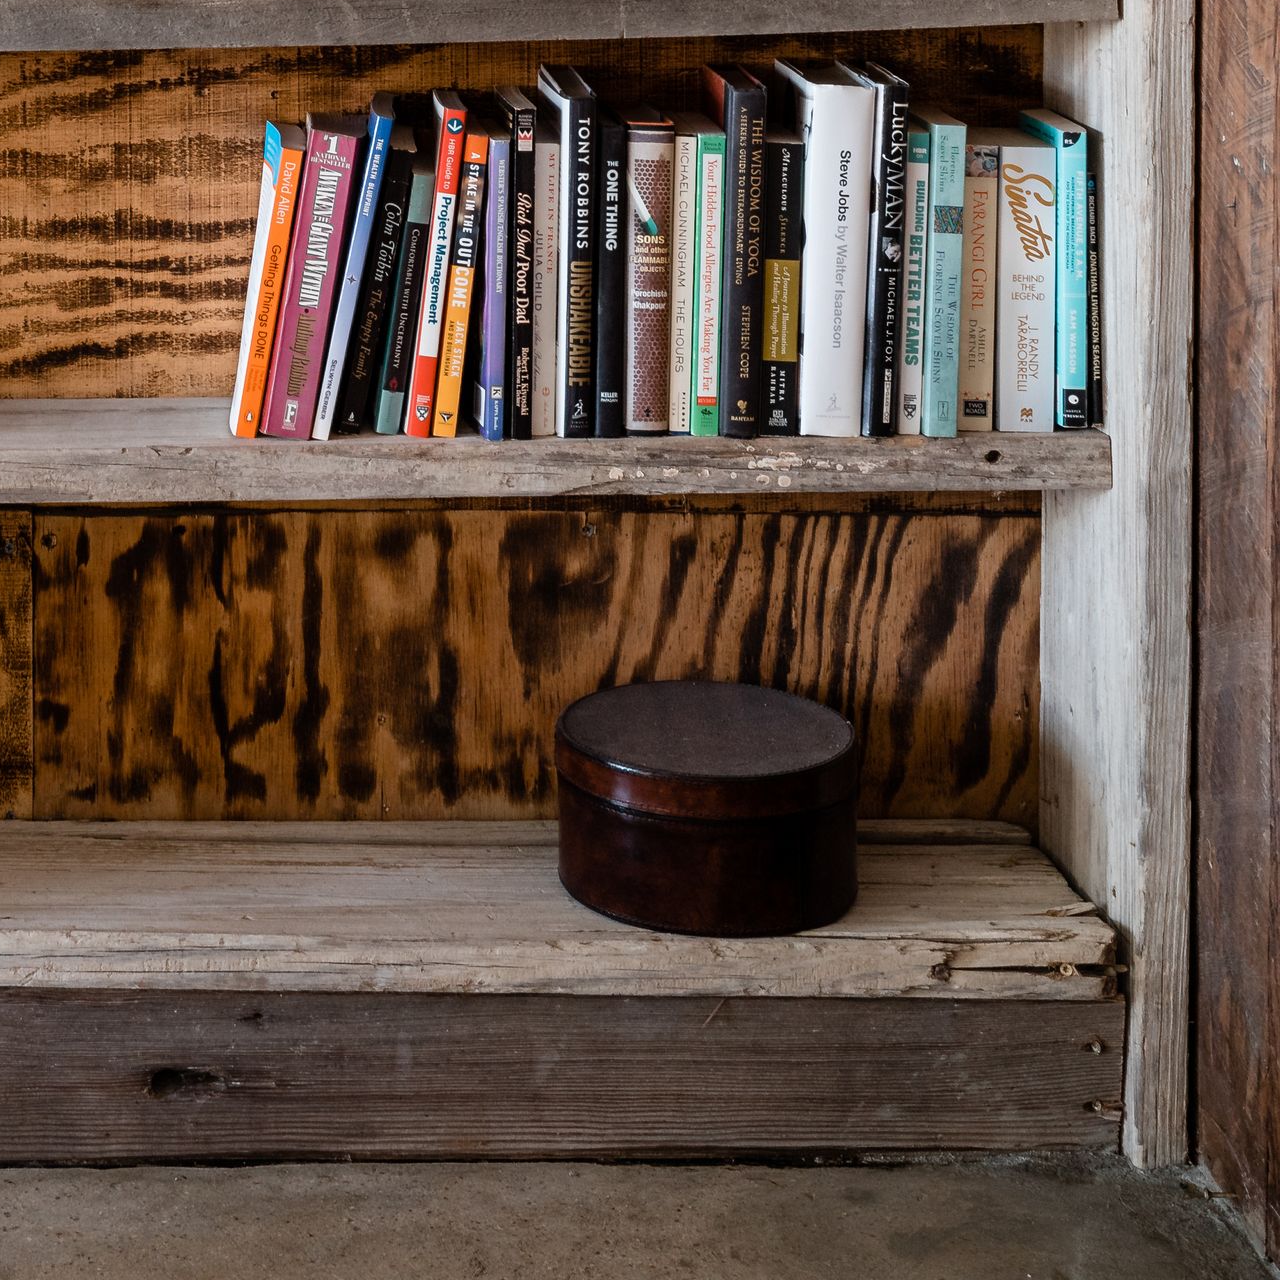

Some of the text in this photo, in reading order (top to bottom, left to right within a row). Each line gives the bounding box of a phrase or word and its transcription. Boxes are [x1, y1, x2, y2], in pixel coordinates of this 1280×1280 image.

[281, 162, 296, 194] David
[311, 158, 350, 169] BESTSELLER
[316, 152, 347, 162] NATIONAL
[576, 118, 590, 248] TONY ROBBINS
[606, 170, 619, 202] ONE
[748, 118, 763, 277] THE WISDOM OF YOGA
[276, 197, 290, 225] Allen
[605, 204, 618, 251] THING
[1001, 163, 1055, 262] Sinatra
[428, 196, 452, 325] Project Management
[636, 235, 665, 244] SONS
[675, 141, 689, 373] MICHAEL CUNNINGHAM THE HOURS
[832, 150, 852, 349] Steve Jobs by Walter Isaacson
[264, 244, 282, 287] Getting
[904, 180, 926, 366] BUILDING BETTER TEAMS
[258, 291, 274, 328] Things
[632, 290, 667, 298] Porochista
[632, 301, 666, 310] Khakpour
[1011, 292, 1045, 301] LEGEND
[255, 331, 268, 359] DONE
[569, 261, 592, 387] UNSHAKEABLE
[740, 305, 751, 379] STEPHEN COPE
[968, 320, 978, 370] DARTNELL
[977, 327, 987, 363] ASHLEY
[450, 321, 465, 377] JACK STACK
[1017, 315, 1028, 392] TARABORRELLI
